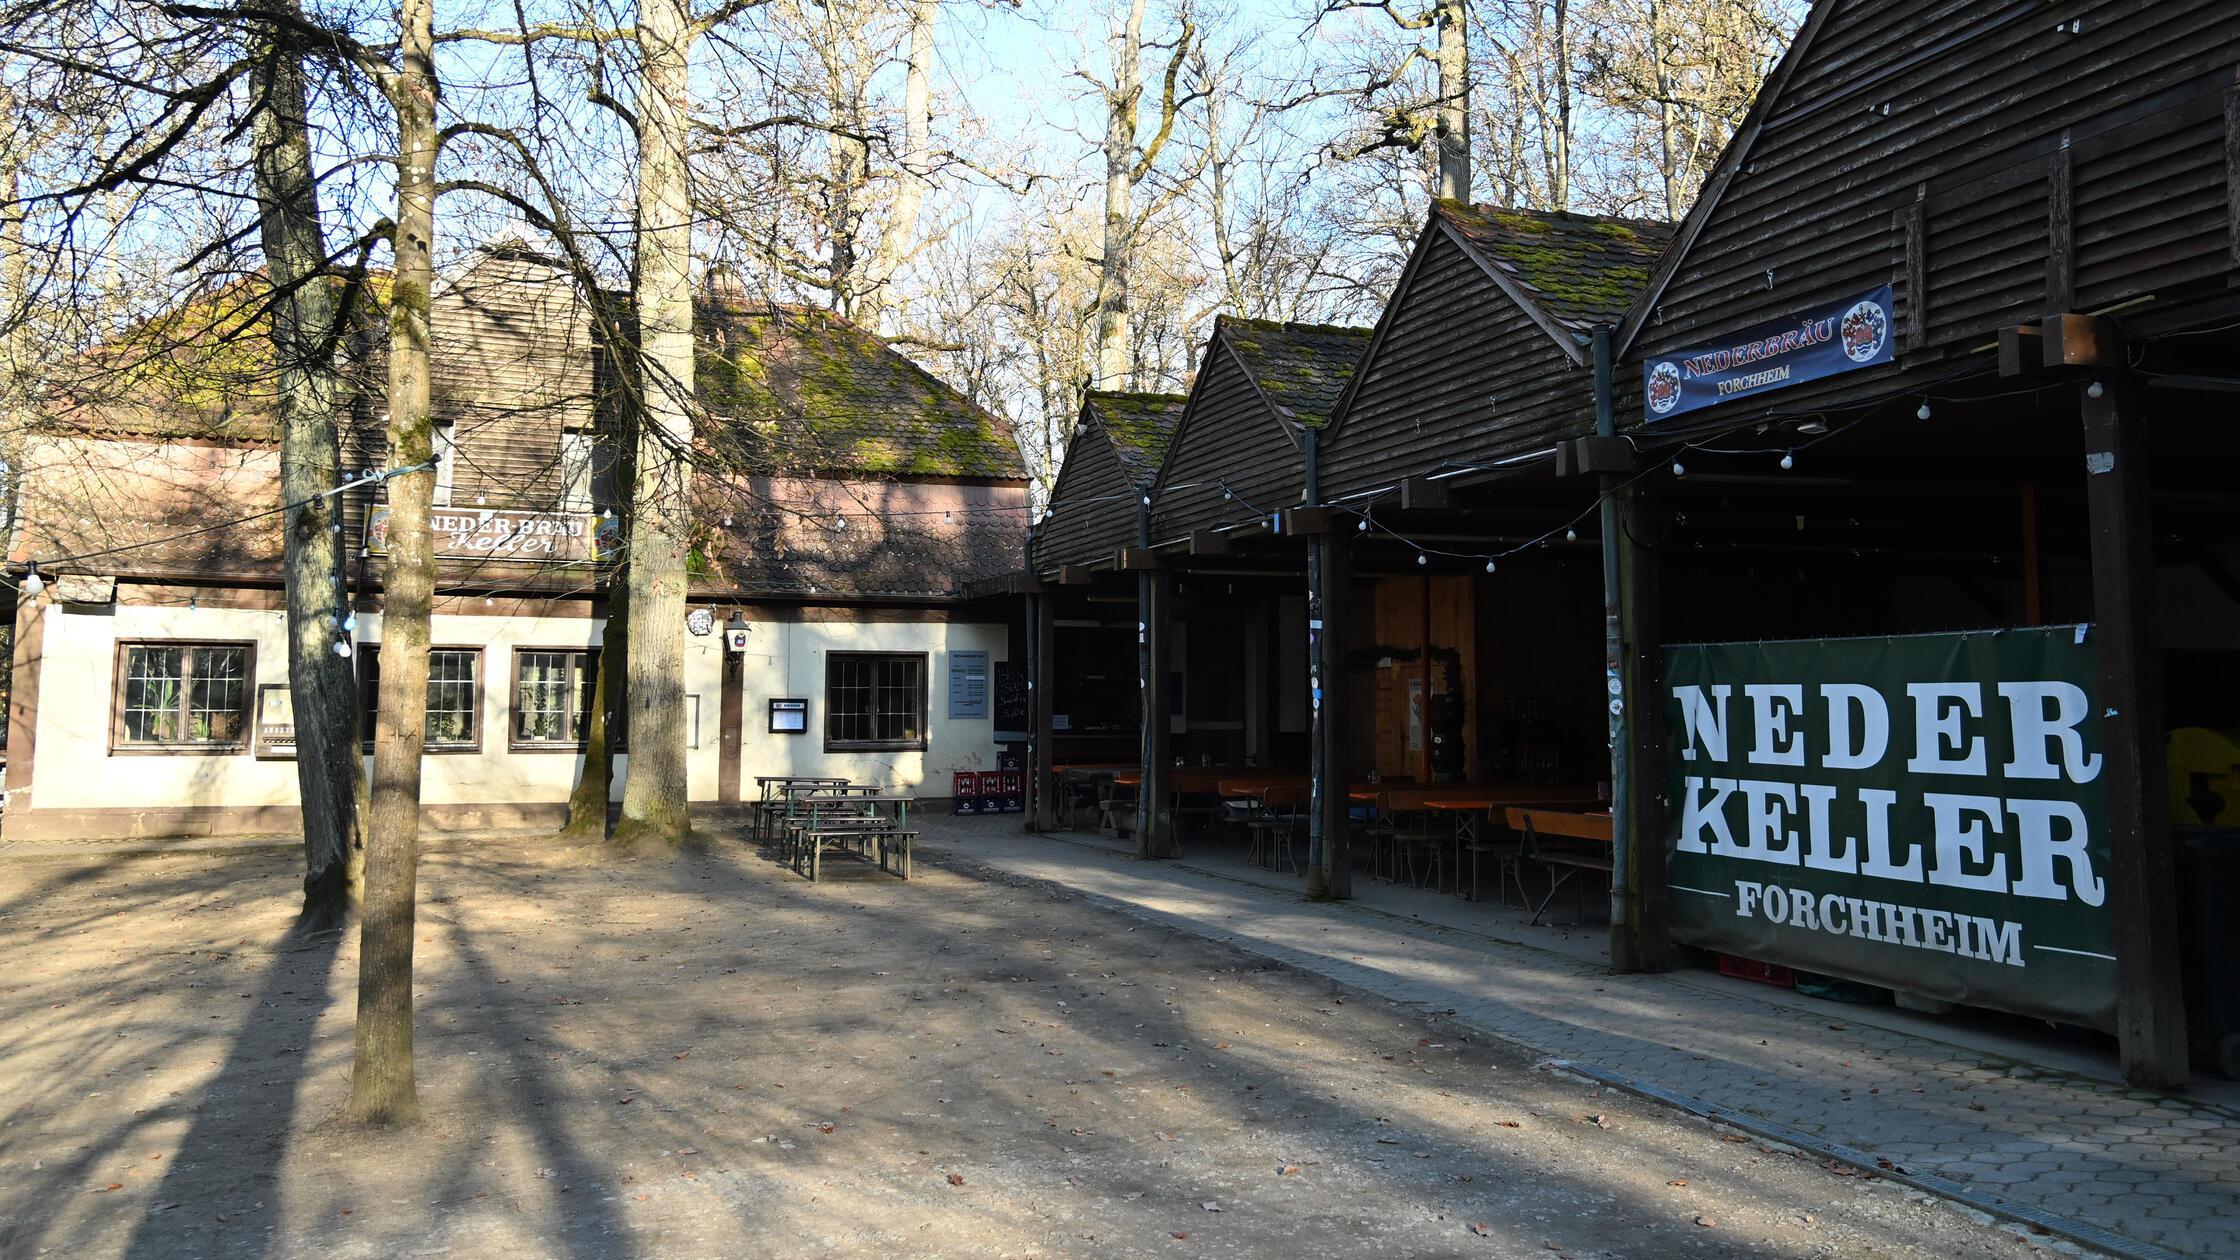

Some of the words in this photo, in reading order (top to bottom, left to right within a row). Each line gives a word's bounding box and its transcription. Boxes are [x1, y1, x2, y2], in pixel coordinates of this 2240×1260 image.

[1683, 317, 1835, 380] NEDERBRÄU
[1717, 365, 1790, 396] FORCHHEIM
[448, 531, 558, 553] Keller
[1673, 681, 2102, 784] NEDER
[1676, 776, 2105, 907] KELLER
[1735, 880, 2026, 967] FORCHHEIM
